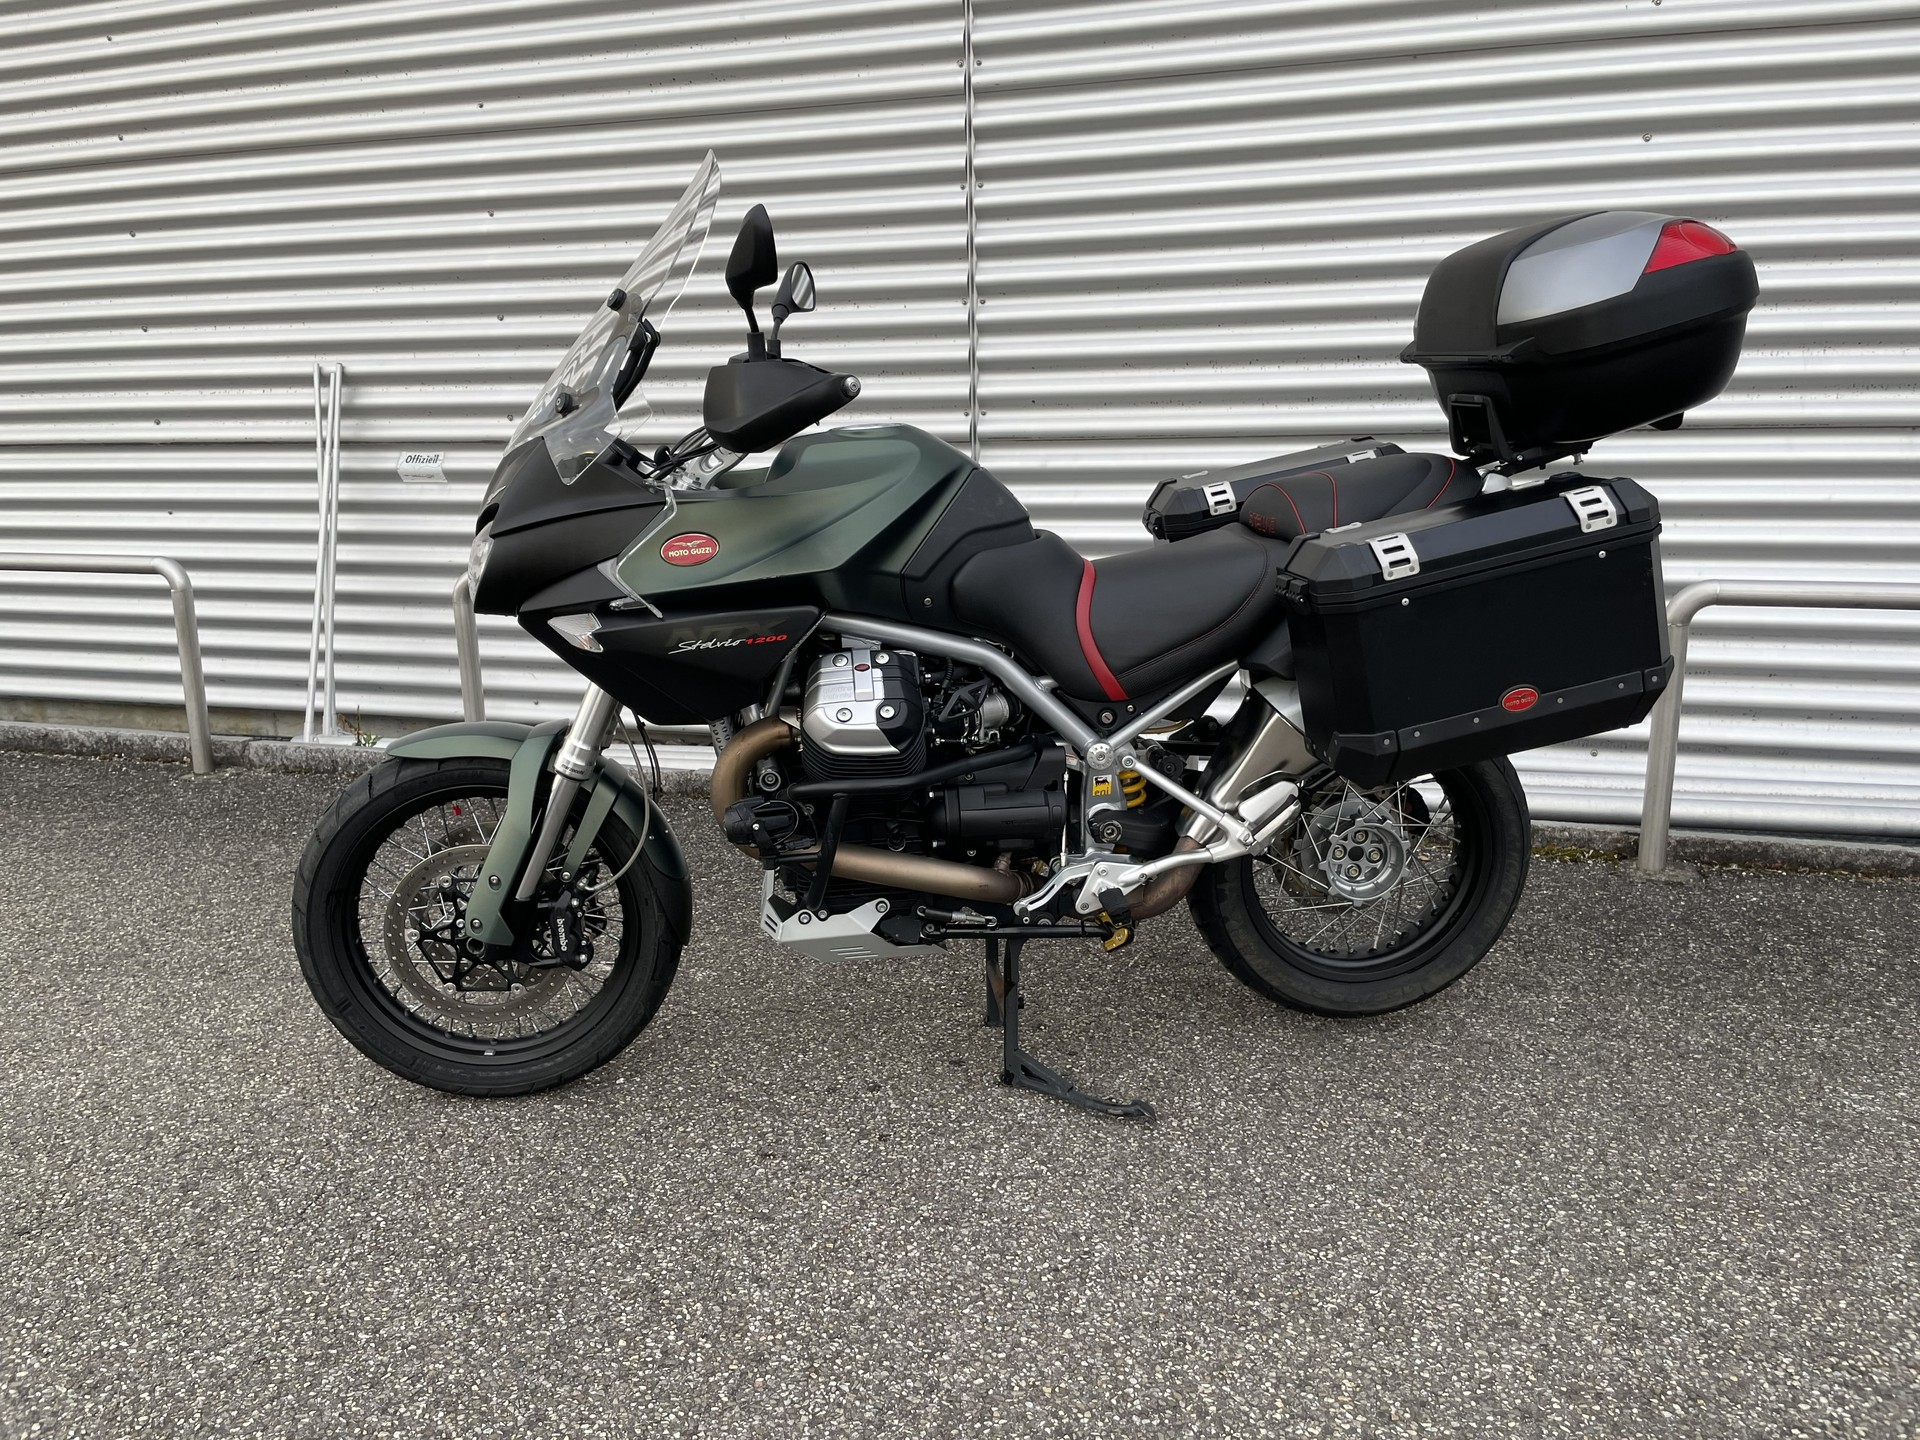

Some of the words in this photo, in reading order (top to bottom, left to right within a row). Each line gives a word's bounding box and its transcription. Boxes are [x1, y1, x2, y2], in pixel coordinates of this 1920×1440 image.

[668, 549, 689, 557] MOTO
[690, 547, 712, 555] GUZZI
[668, 638, 746, 655] Stelvio
[745, 634, 788, 645] 1200
[1094, 786, 1110, 796] eni
[556, 918, 569, 951] brembo
